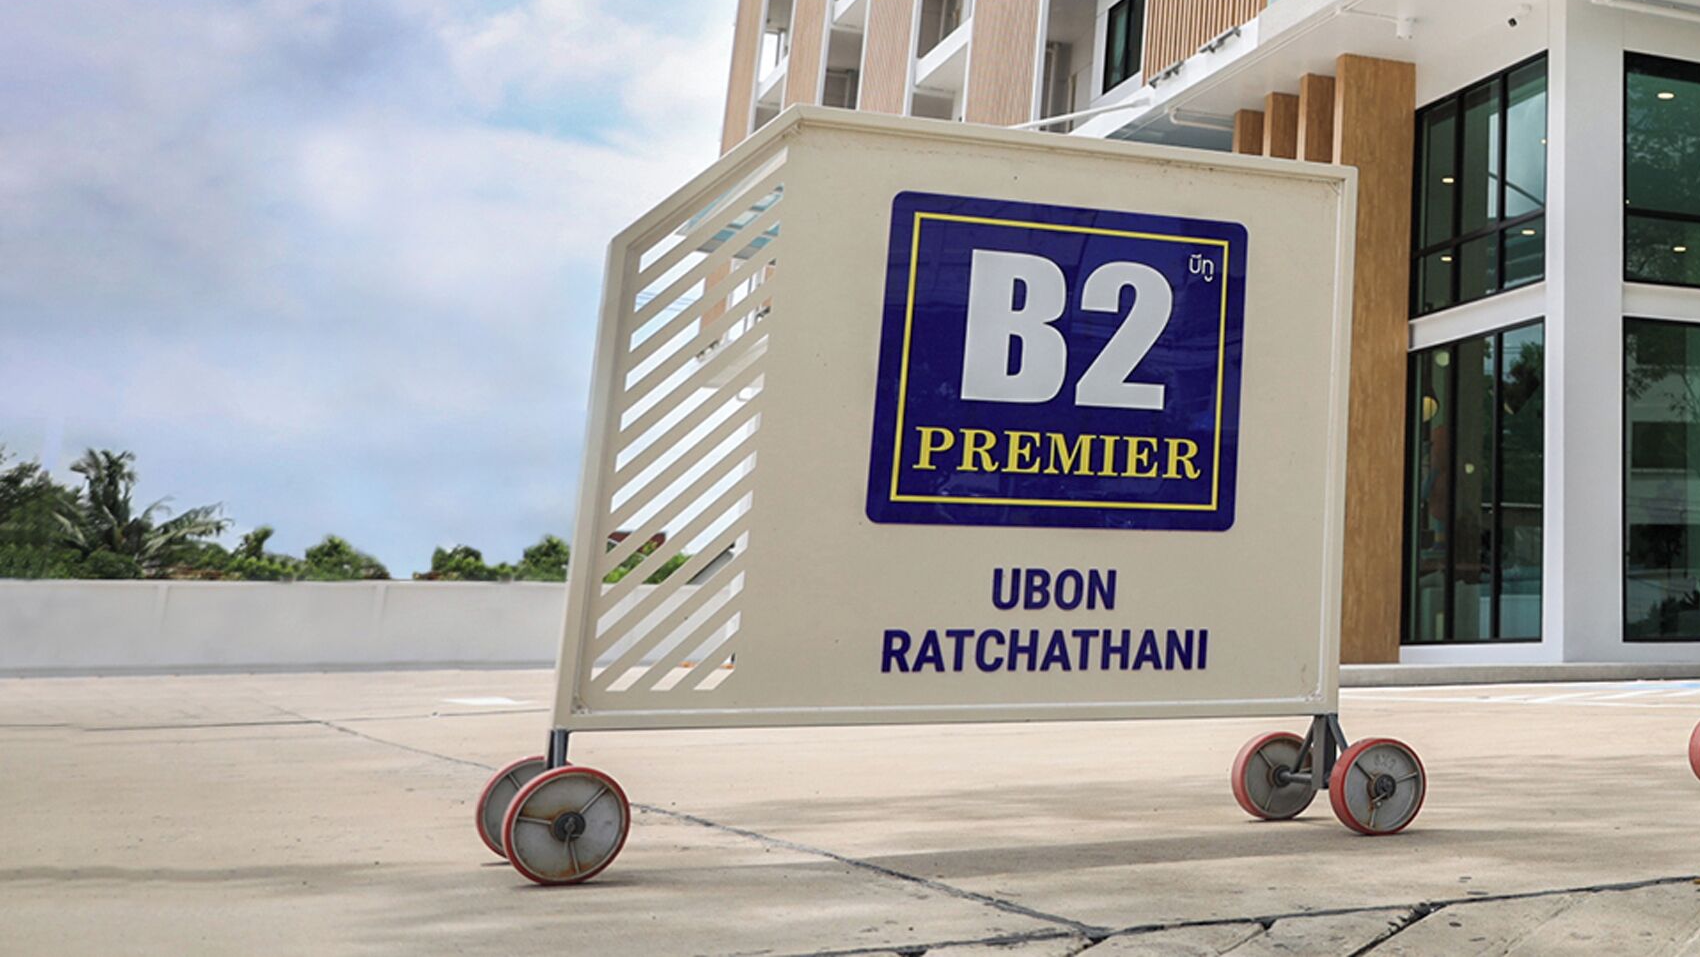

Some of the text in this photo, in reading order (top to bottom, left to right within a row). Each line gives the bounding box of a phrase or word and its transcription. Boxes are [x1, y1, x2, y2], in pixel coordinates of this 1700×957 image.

[961, 249, 1173, 410] B2
[912, 426, 1201, 479] PREMIER
[991, 567, 1117, 611] UBON
[880, 628, 1209, 674] RATCHATHANI
